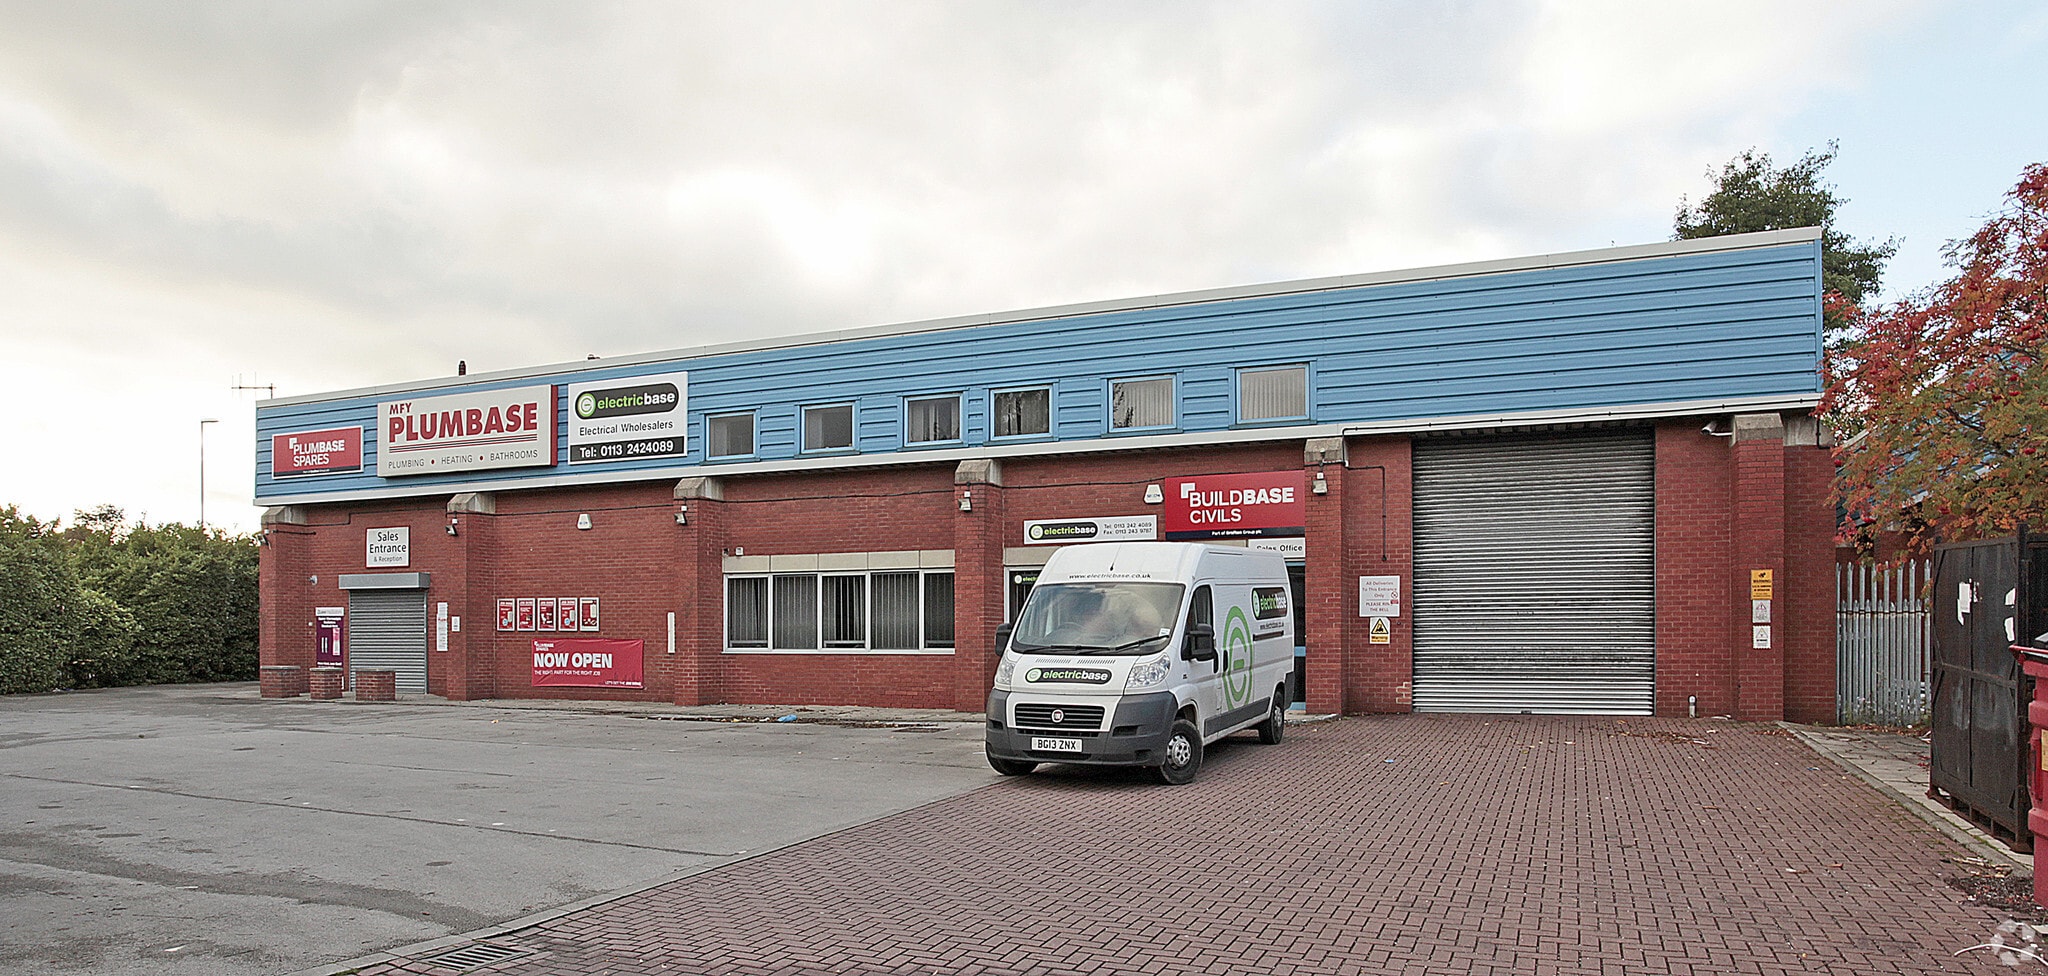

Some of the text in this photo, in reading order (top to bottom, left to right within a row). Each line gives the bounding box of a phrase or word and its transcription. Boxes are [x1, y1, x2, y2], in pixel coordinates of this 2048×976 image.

[389, 402, 412, 415] MFY
[598, 392, 675, 409] electricbase
[389, 402, 538, 443] PLUMBASE
[579, 420, 673, 436] Electrical Wholesalers
[293, 439, 345, 456] PLUMBASE
[579, 440, 674, 458] Tel: 0113 2424089
[293, 453, 330, 467] SPARES
[388, 449, 538, 469] PLUMBING HEATING BATHROOMS
[1189, 487, 1295, 508] BUILDBASE
[1189, 508, 1242, 524] CIVILS
[377, 531, 399, 542] Sales
[1044, 526, 1096, 535] electricbase
[369, 543, 407, 553] Entrance
[533, 652, 613, 668] NOW OPEN
[1042, 670, 1109, 681] electricbase
[1037, 739, 1076, 750] BG13 ZNX
